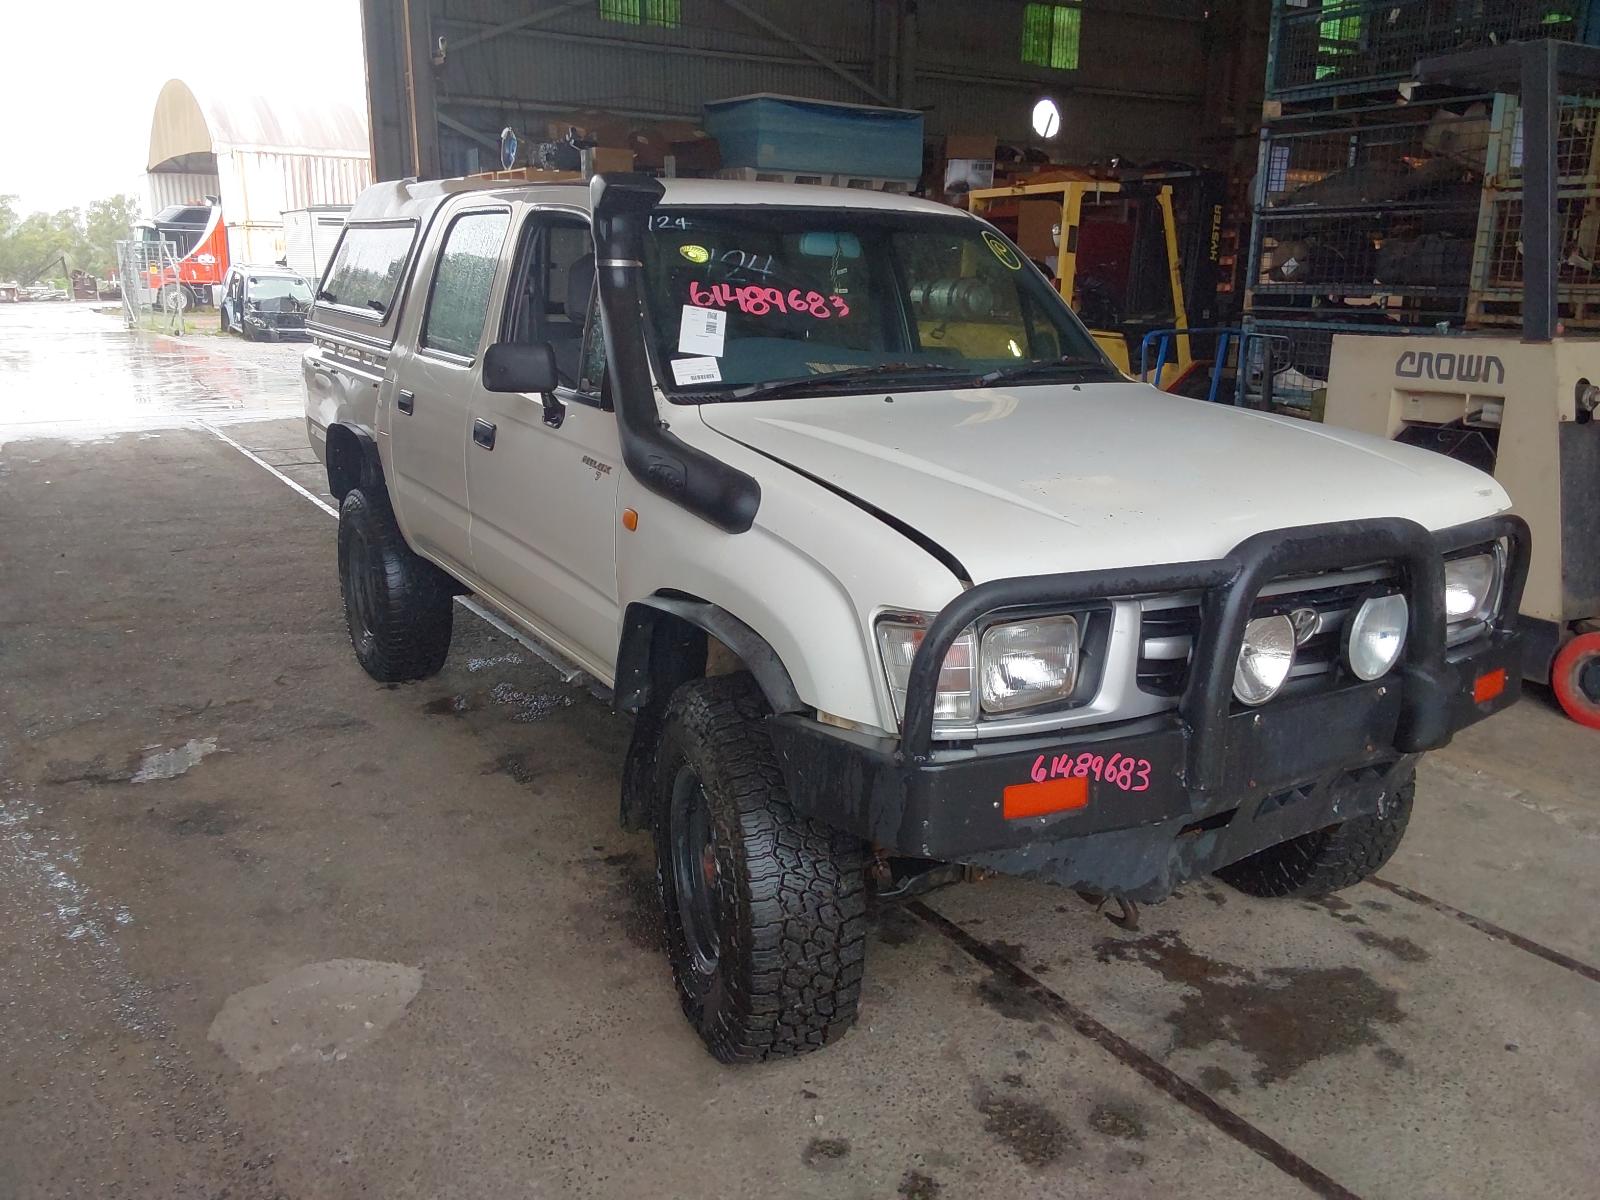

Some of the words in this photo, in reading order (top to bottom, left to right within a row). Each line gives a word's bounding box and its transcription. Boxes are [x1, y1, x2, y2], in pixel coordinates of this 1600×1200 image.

[648, 215, 693, 231] 124
[1210, 204, 1222, 261] HYSTER
[708, 248, 773, 281] 124
[690, 281, 850, 319] 61489683
[1031, 752, 1151, 791] 61489683
